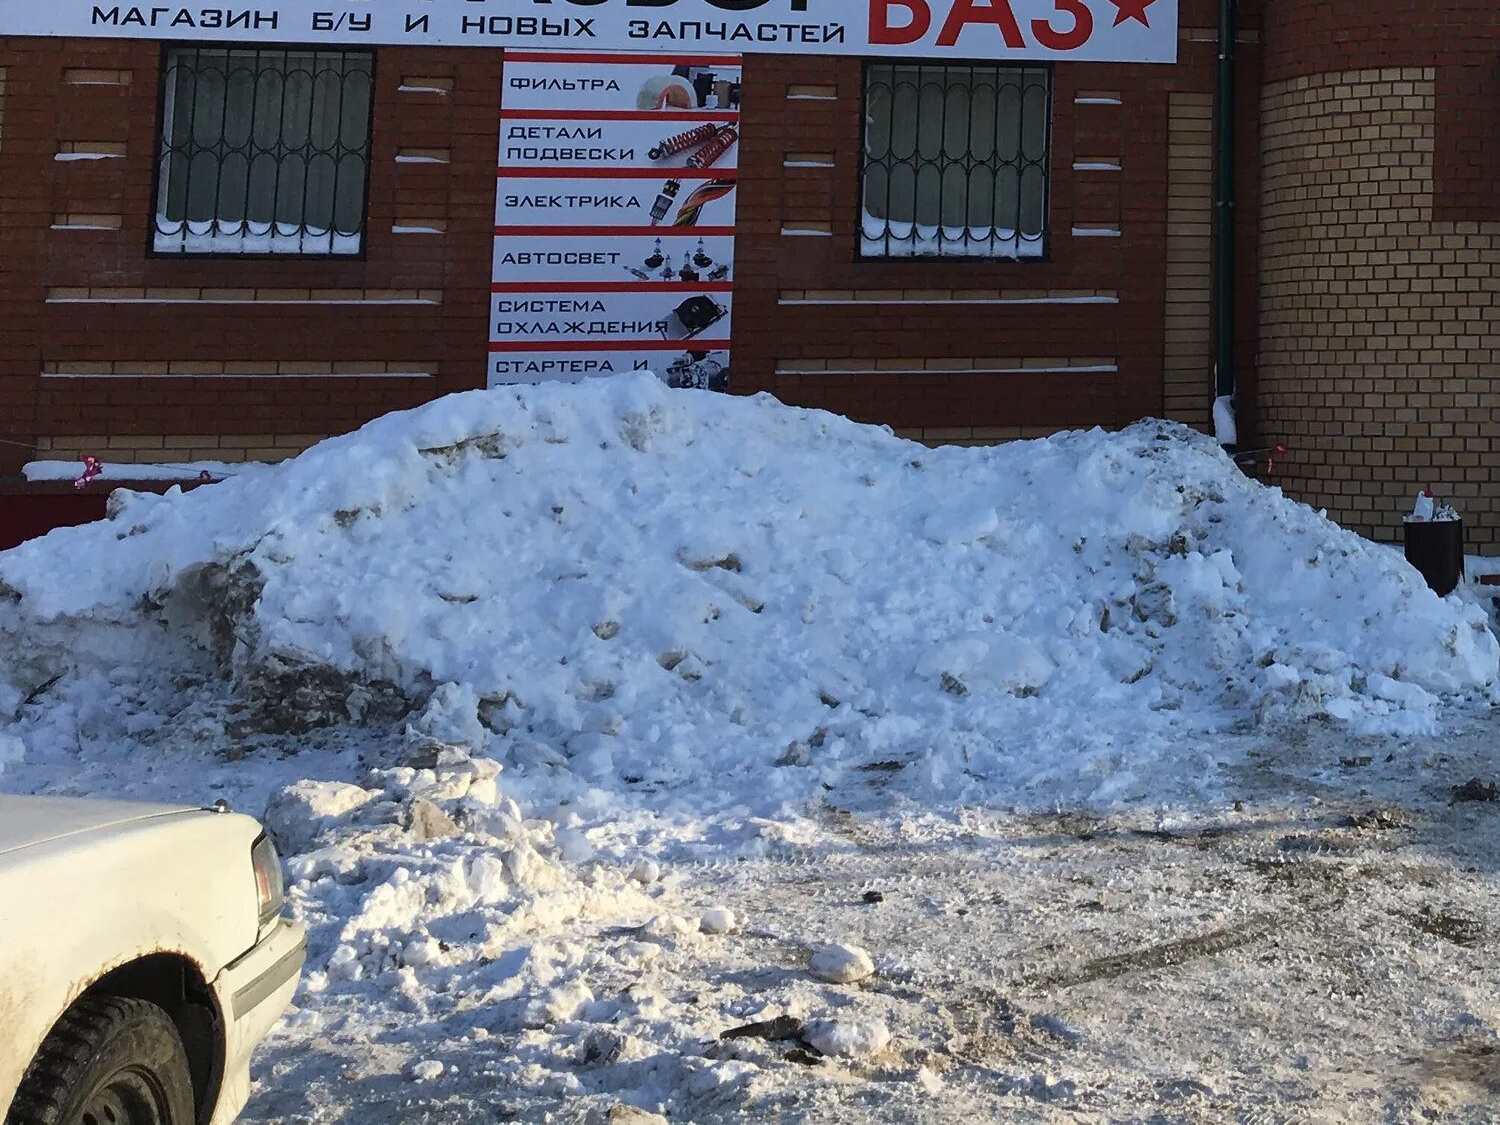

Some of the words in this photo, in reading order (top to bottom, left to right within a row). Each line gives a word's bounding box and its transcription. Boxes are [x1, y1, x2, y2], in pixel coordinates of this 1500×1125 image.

[91, 5, 278, 29] МАГАЗИН
[311, 13, 372, 32] Б/У
[404, 14, 429, 33] И
[462, 15, 596, 37] НОВЫХ
[628, 19, 845, 44] ЗАПЧАСТЕЙ
[510, 77, 621, 92] ФИЛЬТРА
[507, 126, 602, 140] ДЕТАЛИ
[507, 147, 634, 161] ПОДВЕСКИ
[504, 195, 641, 209] ЭЛЕКТРИКА
[501, 252, 621, 265] АВТОСВЕТ
[498, 299, 606, 313] СИСТЕМА
[497, 320, 669, 335] ОХЛАЖДЕНИЯ
[495, 360, 614, 373] СТАРТЕРА
[633, 359, 648, 371] И
